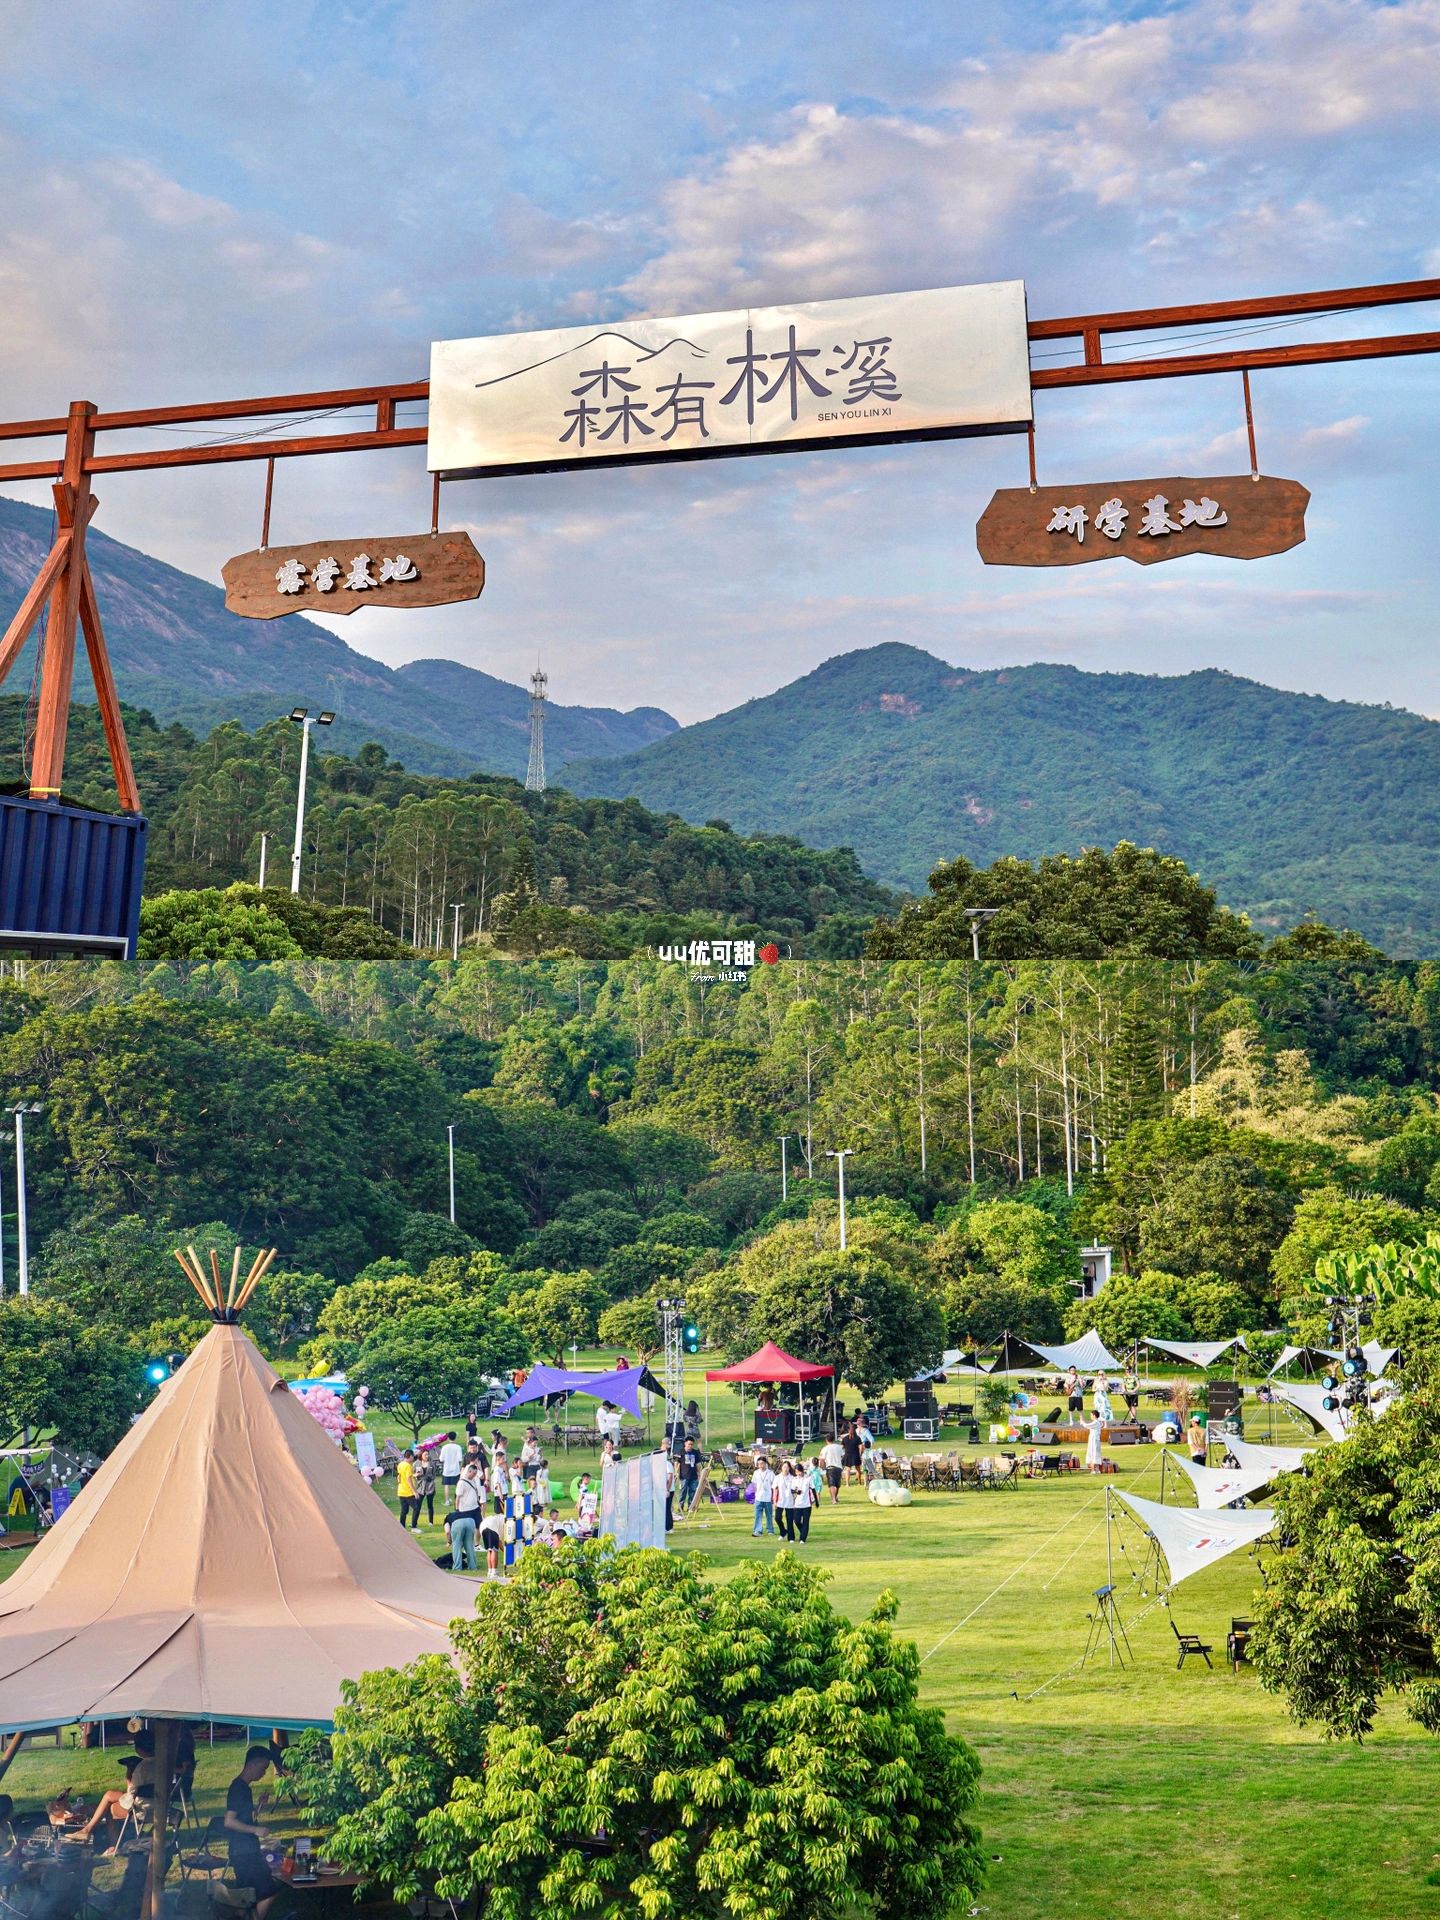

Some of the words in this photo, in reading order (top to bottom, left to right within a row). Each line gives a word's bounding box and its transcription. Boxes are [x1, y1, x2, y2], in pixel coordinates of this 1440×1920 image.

[559, 325, 902, 447] 森有林溪
[818, 412, 838, 421] SEN
[840, 410, 861, 419] YOU
[863, 408, 879, 417] LIN
[882, 408, 891, 416] XI
[1047, 495, 1228, 543] 研学基地
[276, 553, 418, 594] 露营基地
